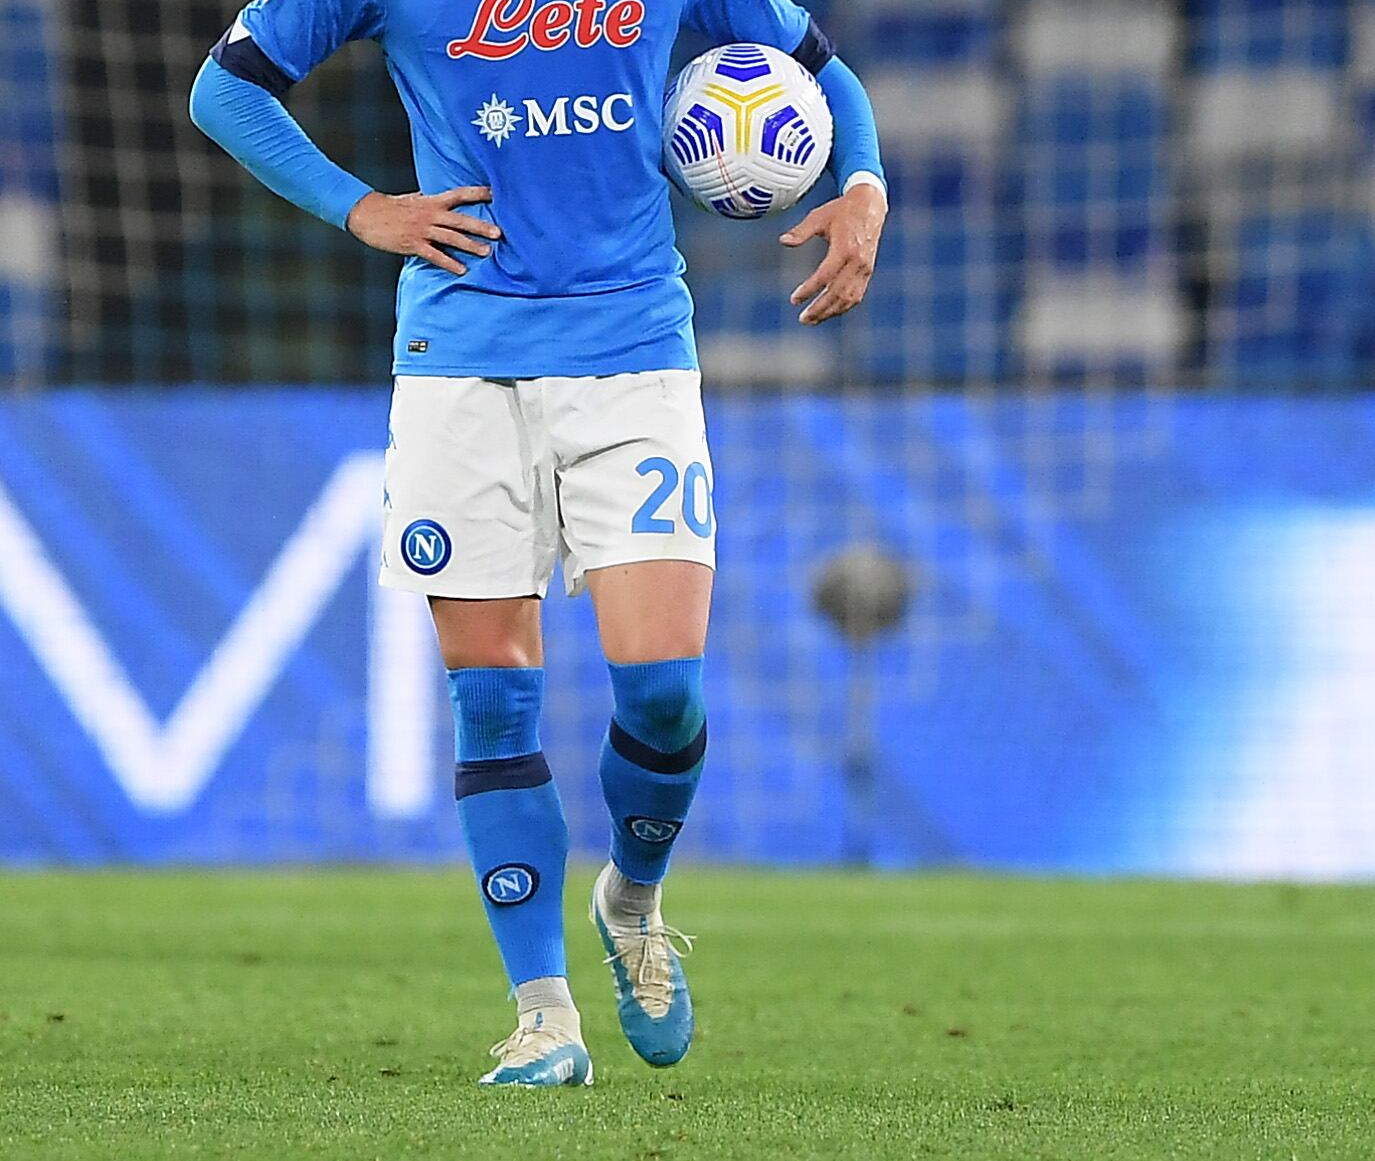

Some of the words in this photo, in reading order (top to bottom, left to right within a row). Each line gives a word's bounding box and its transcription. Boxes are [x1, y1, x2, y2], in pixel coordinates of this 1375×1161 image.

[522, 93, 635, 137] MSC
[631, 456, 712, 539] 20
[412, 532, 437, 561] N
[642, 820, 664, 836] N
[497, 872, 522, 897] N
